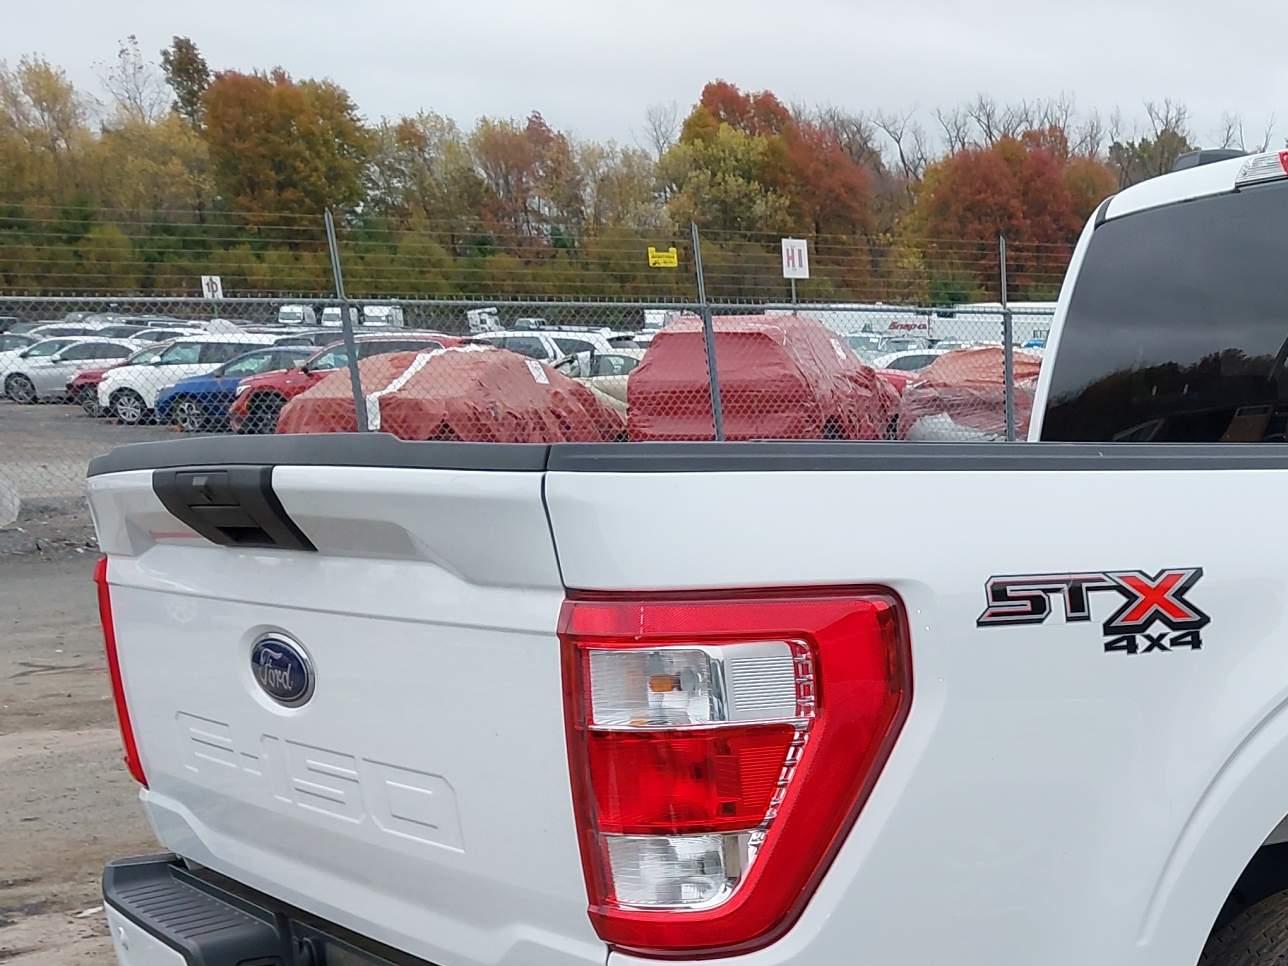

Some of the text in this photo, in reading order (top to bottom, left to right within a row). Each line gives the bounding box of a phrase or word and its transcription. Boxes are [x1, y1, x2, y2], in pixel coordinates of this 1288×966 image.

[976, 567, 1211, 636] STX
[257, 646, 295, 691] Ford
[175, 710, 465, 854] F-150
